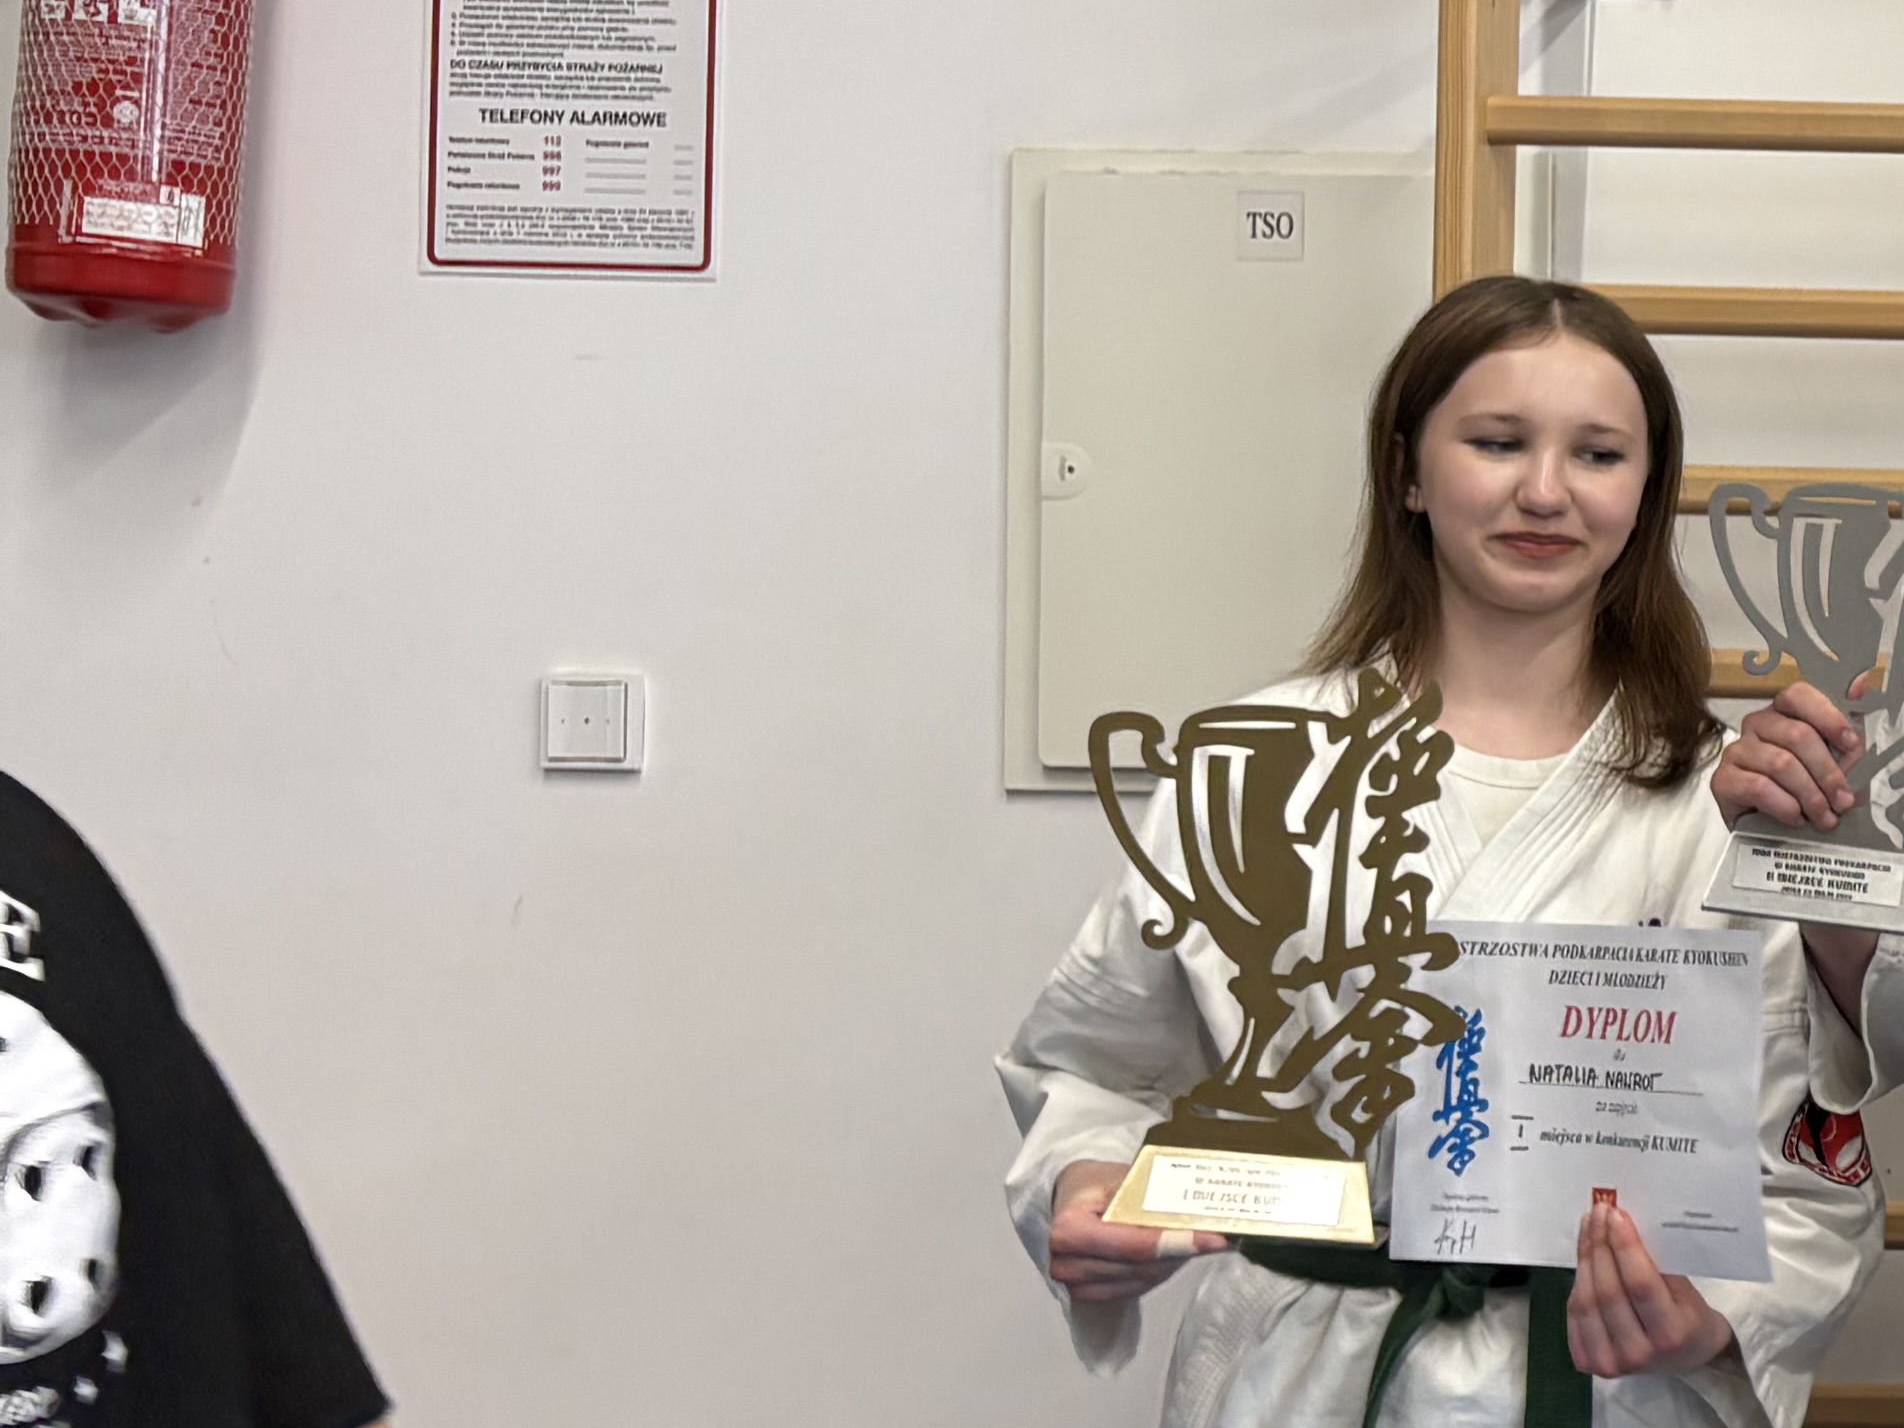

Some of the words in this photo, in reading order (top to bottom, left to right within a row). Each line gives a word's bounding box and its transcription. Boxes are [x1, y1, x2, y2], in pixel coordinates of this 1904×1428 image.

[479, 108, 565, 125] TELEFONY
[569, 109, 668, 128] ALARMOWE
[1246, 211, 1294, 240] TSO
[1459, 940, 1549, 959] STRZOSTWA
[1548, 969, 1595, 987] DZIECI
[1559, 1004, 1678, 1045] DYPLOM
[1528, 1062, 1599, 1086] NATALIA
[1651, 1134, 1699, 1155] KUMITE
